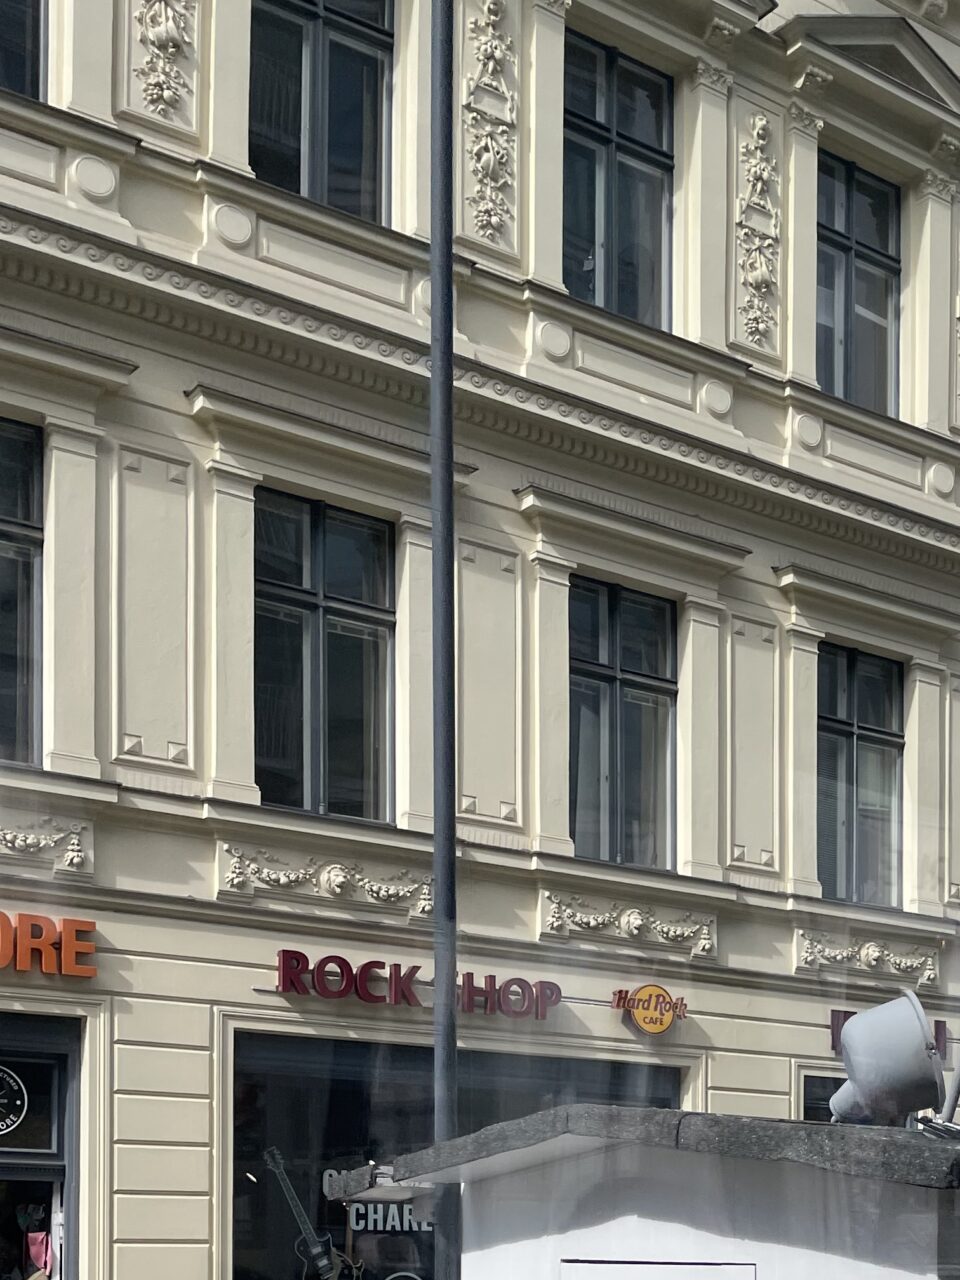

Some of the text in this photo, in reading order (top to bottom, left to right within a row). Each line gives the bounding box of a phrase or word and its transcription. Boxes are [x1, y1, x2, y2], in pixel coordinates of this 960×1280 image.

[276, 949, 562, 1020] ROCK HOP
[611, 989, 688, 1020] Hard Rock
[642, 1016, 664, 1026] CAFE
